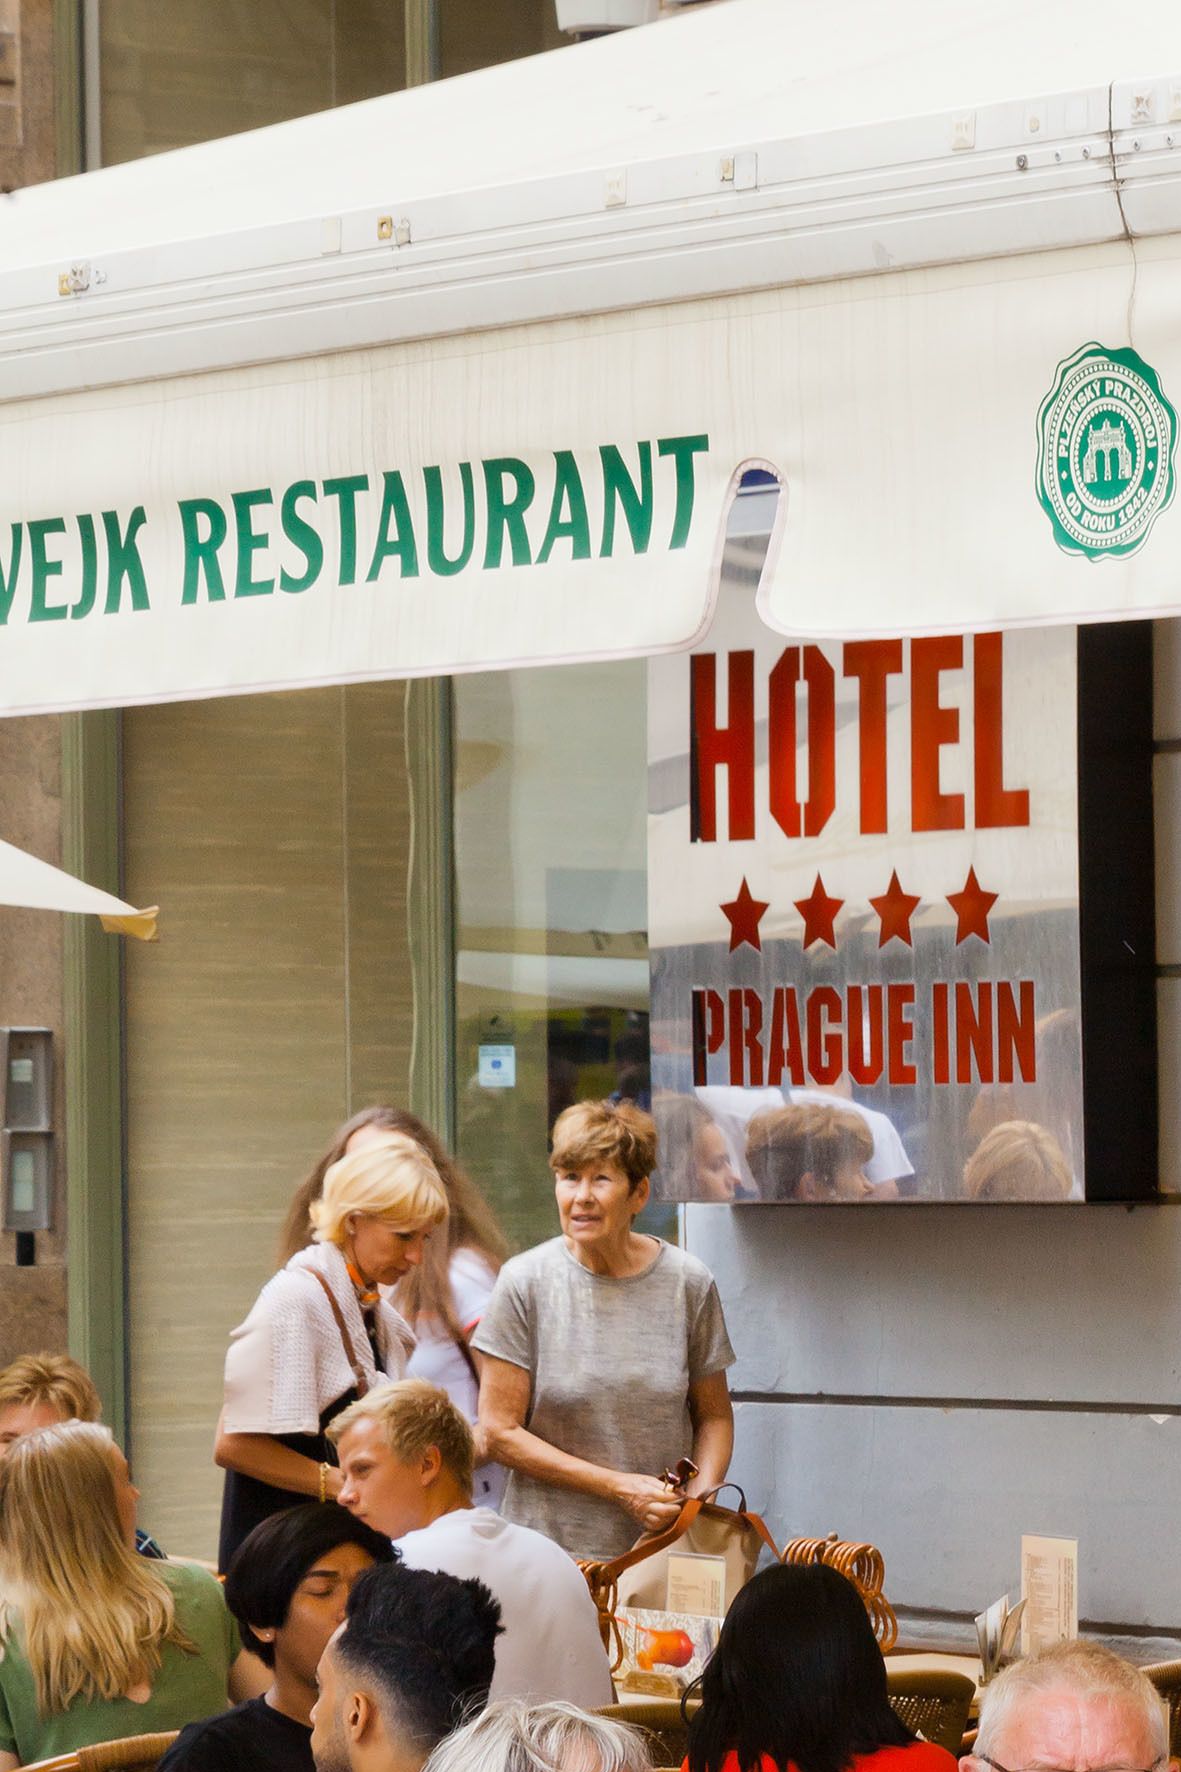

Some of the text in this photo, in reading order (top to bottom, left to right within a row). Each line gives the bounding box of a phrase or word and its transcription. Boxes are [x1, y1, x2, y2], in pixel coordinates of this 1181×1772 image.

[1105, 379, 1158, 449] PRAZDROJ
[177, 433, 710, 606] RESTAURANT
[1065, 486, 1149, 532] OD ROKU 1842
[690, 632, 1030, 843] HOTEL
[691, 981, 1036, 1087] PRAGUE INN
